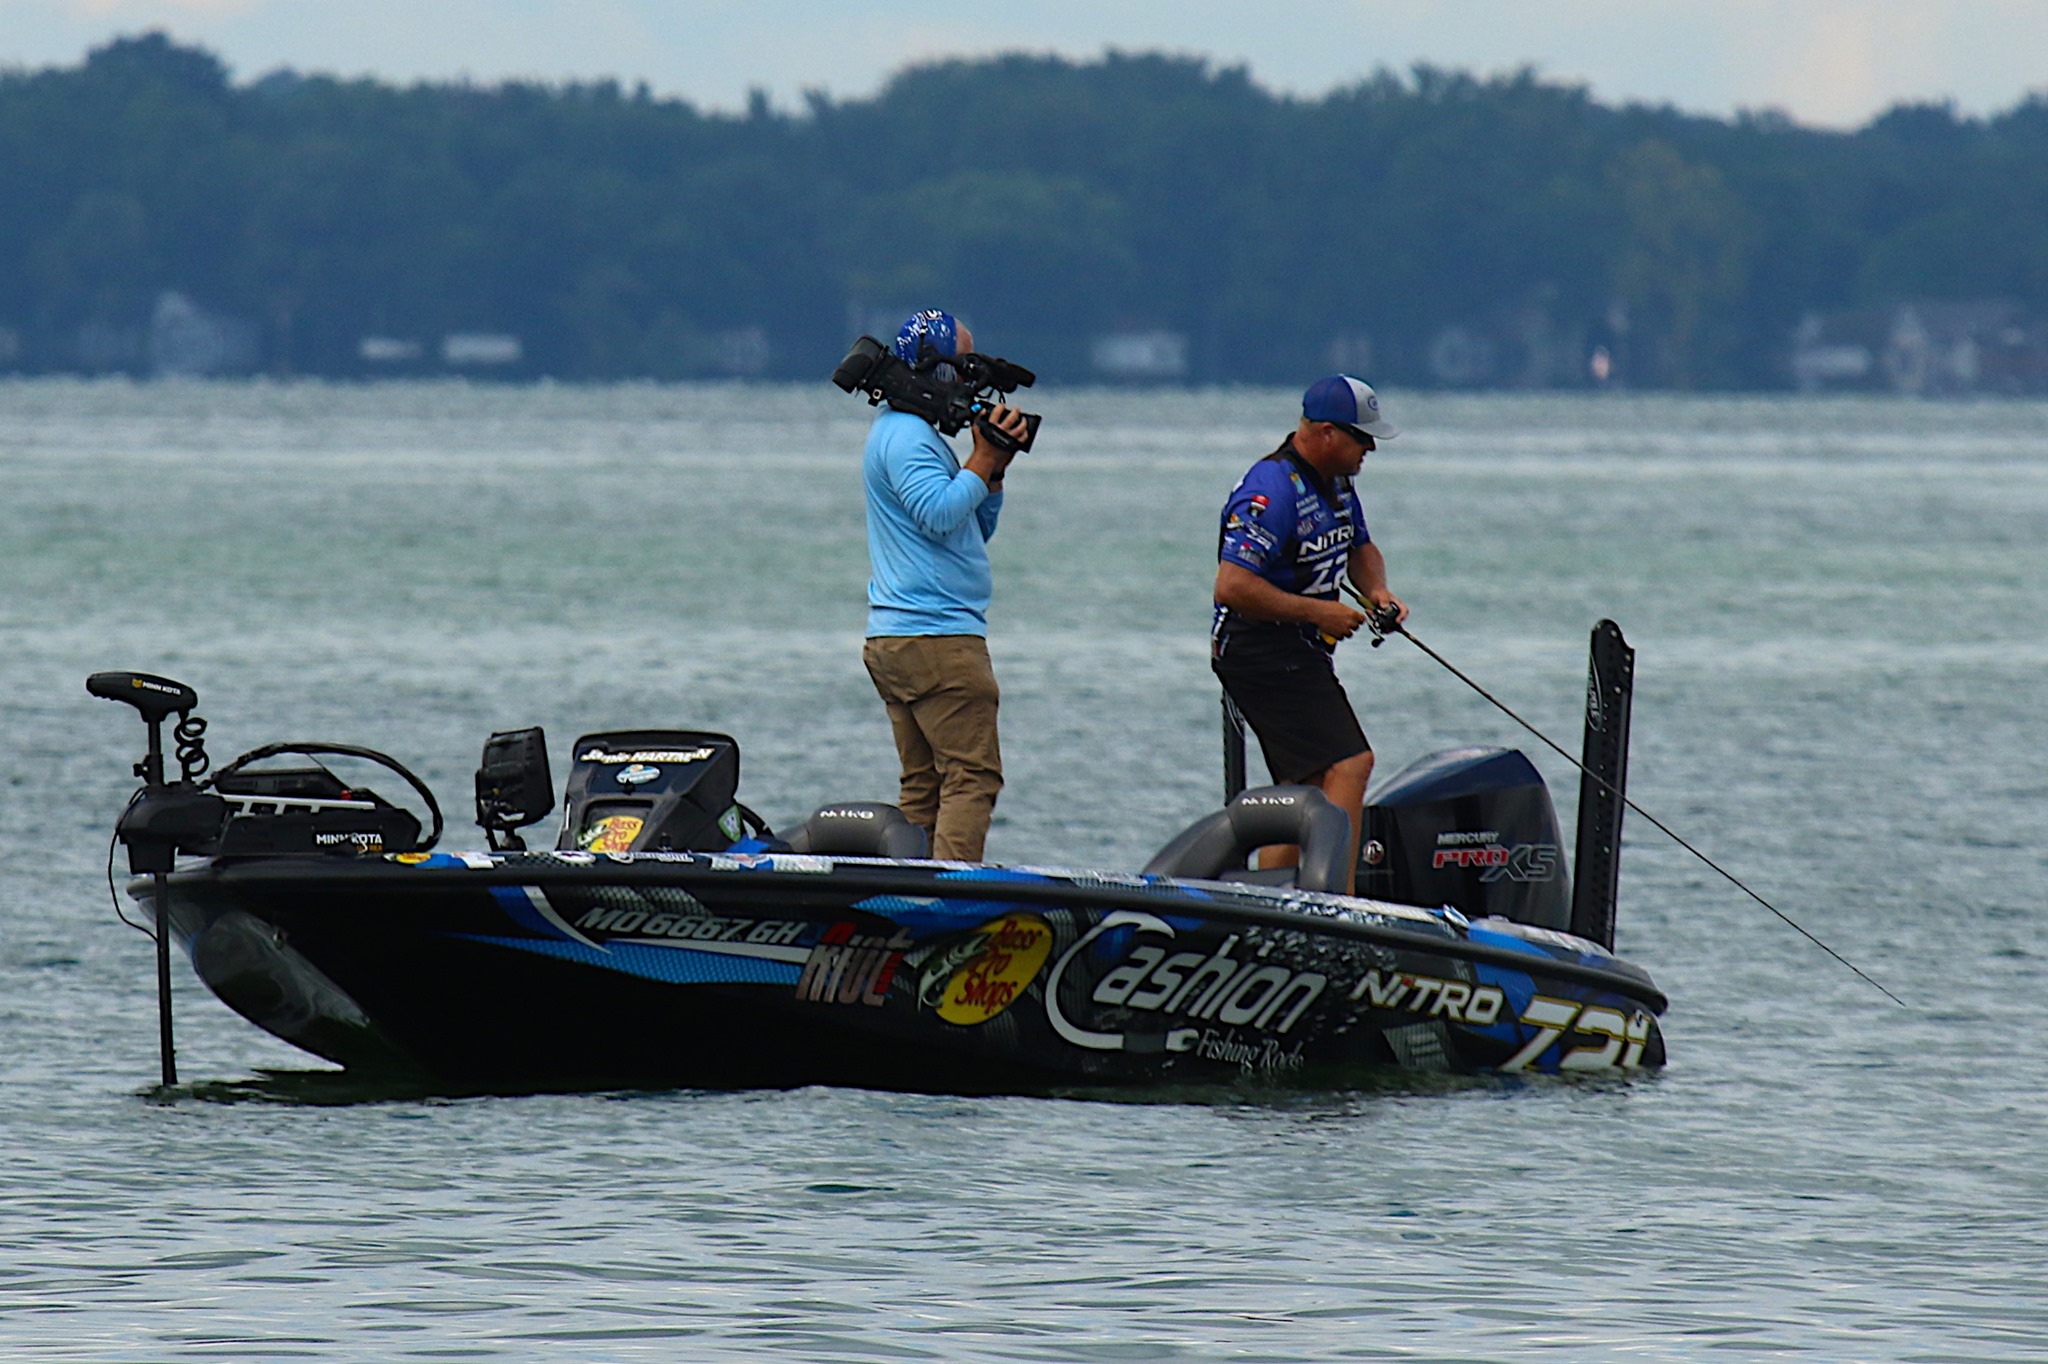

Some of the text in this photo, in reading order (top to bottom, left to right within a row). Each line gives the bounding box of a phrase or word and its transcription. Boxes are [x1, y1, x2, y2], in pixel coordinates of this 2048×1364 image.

[1437, 832, 1499, 845] MERCURY
[988, 919, 1043, 951] Bass
[1046, 910, 1328, 1050] Cashion
[1349, 968, 1504, 1026] NITRO
[1196, 1028, 1261, 1069] Fishing
